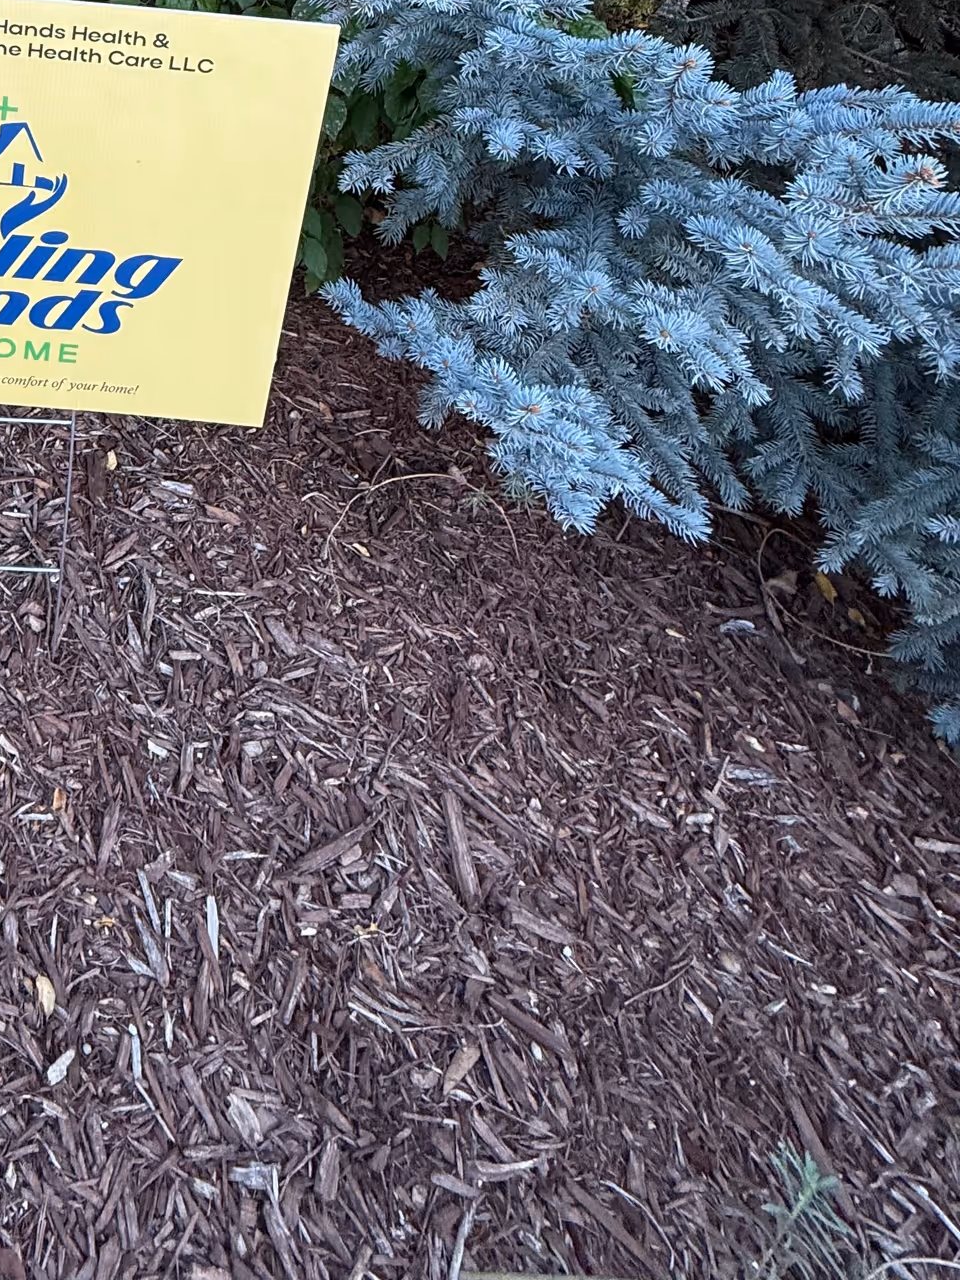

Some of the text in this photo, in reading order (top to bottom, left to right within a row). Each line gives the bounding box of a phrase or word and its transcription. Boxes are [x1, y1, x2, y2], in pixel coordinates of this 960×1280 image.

[71, 25, 147, 47] Health
[152, 33, 170, 49] &
[27, 43, 102, 64] Health
[108, 50, 163, 69] Care
[168, 55, 215, 74] LLC
[1, 375, 49, 389] comfort
[51, 378, 67, 391] of
[67, 381, 99, 392] your
[99, 381, 140, 395] home!
